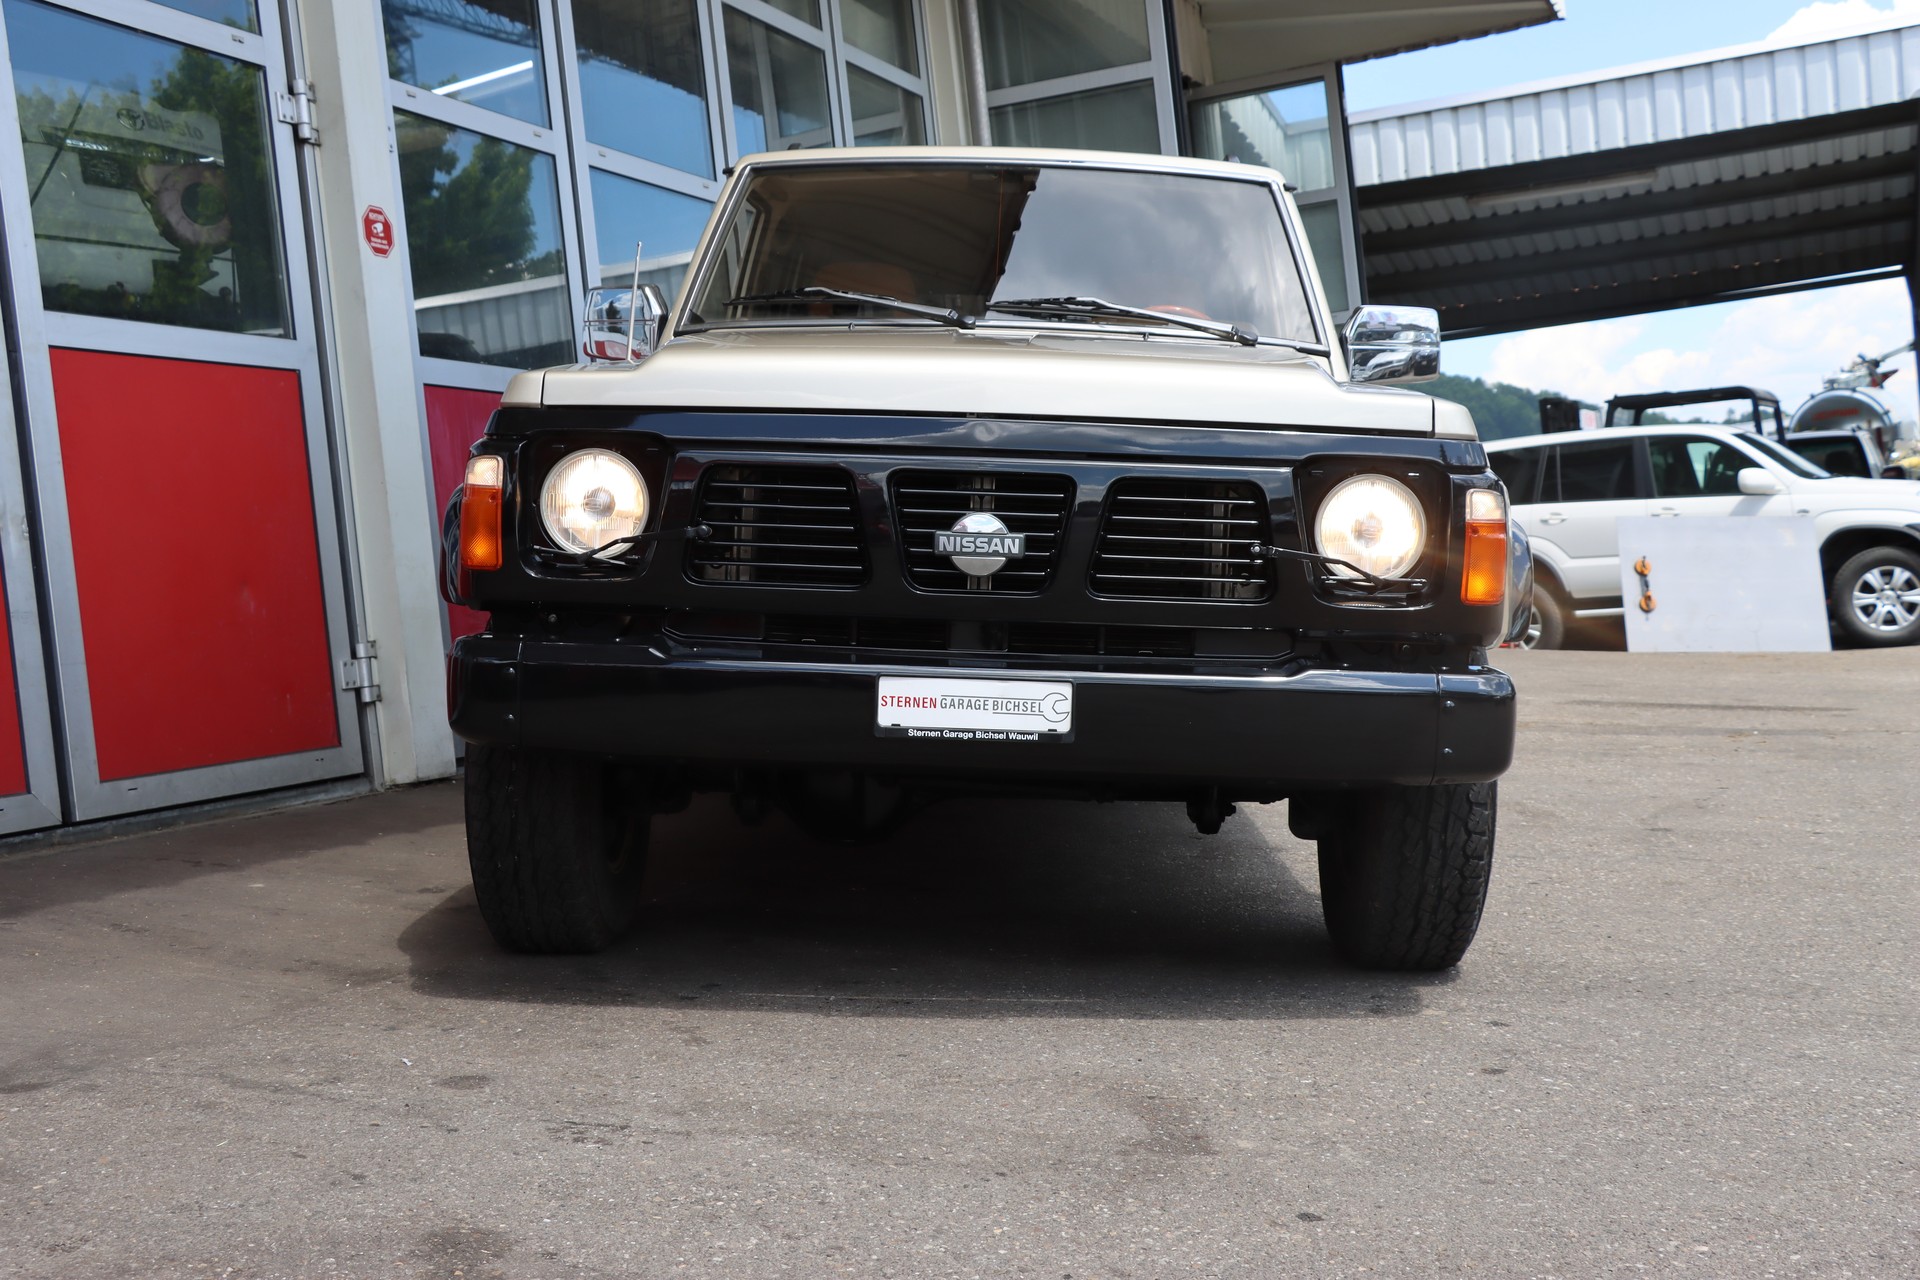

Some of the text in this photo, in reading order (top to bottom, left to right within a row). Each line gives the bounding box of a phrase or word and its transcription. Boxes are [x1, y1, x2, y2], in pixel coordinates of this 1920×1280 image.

[938, 535, 1020, 554] NISSAN
[880, 695, 1044, 713] STERNEN GARAGE BICHSEL
[907, 728, 1039, 741] Sternen Garage Bichsel Wauwil
